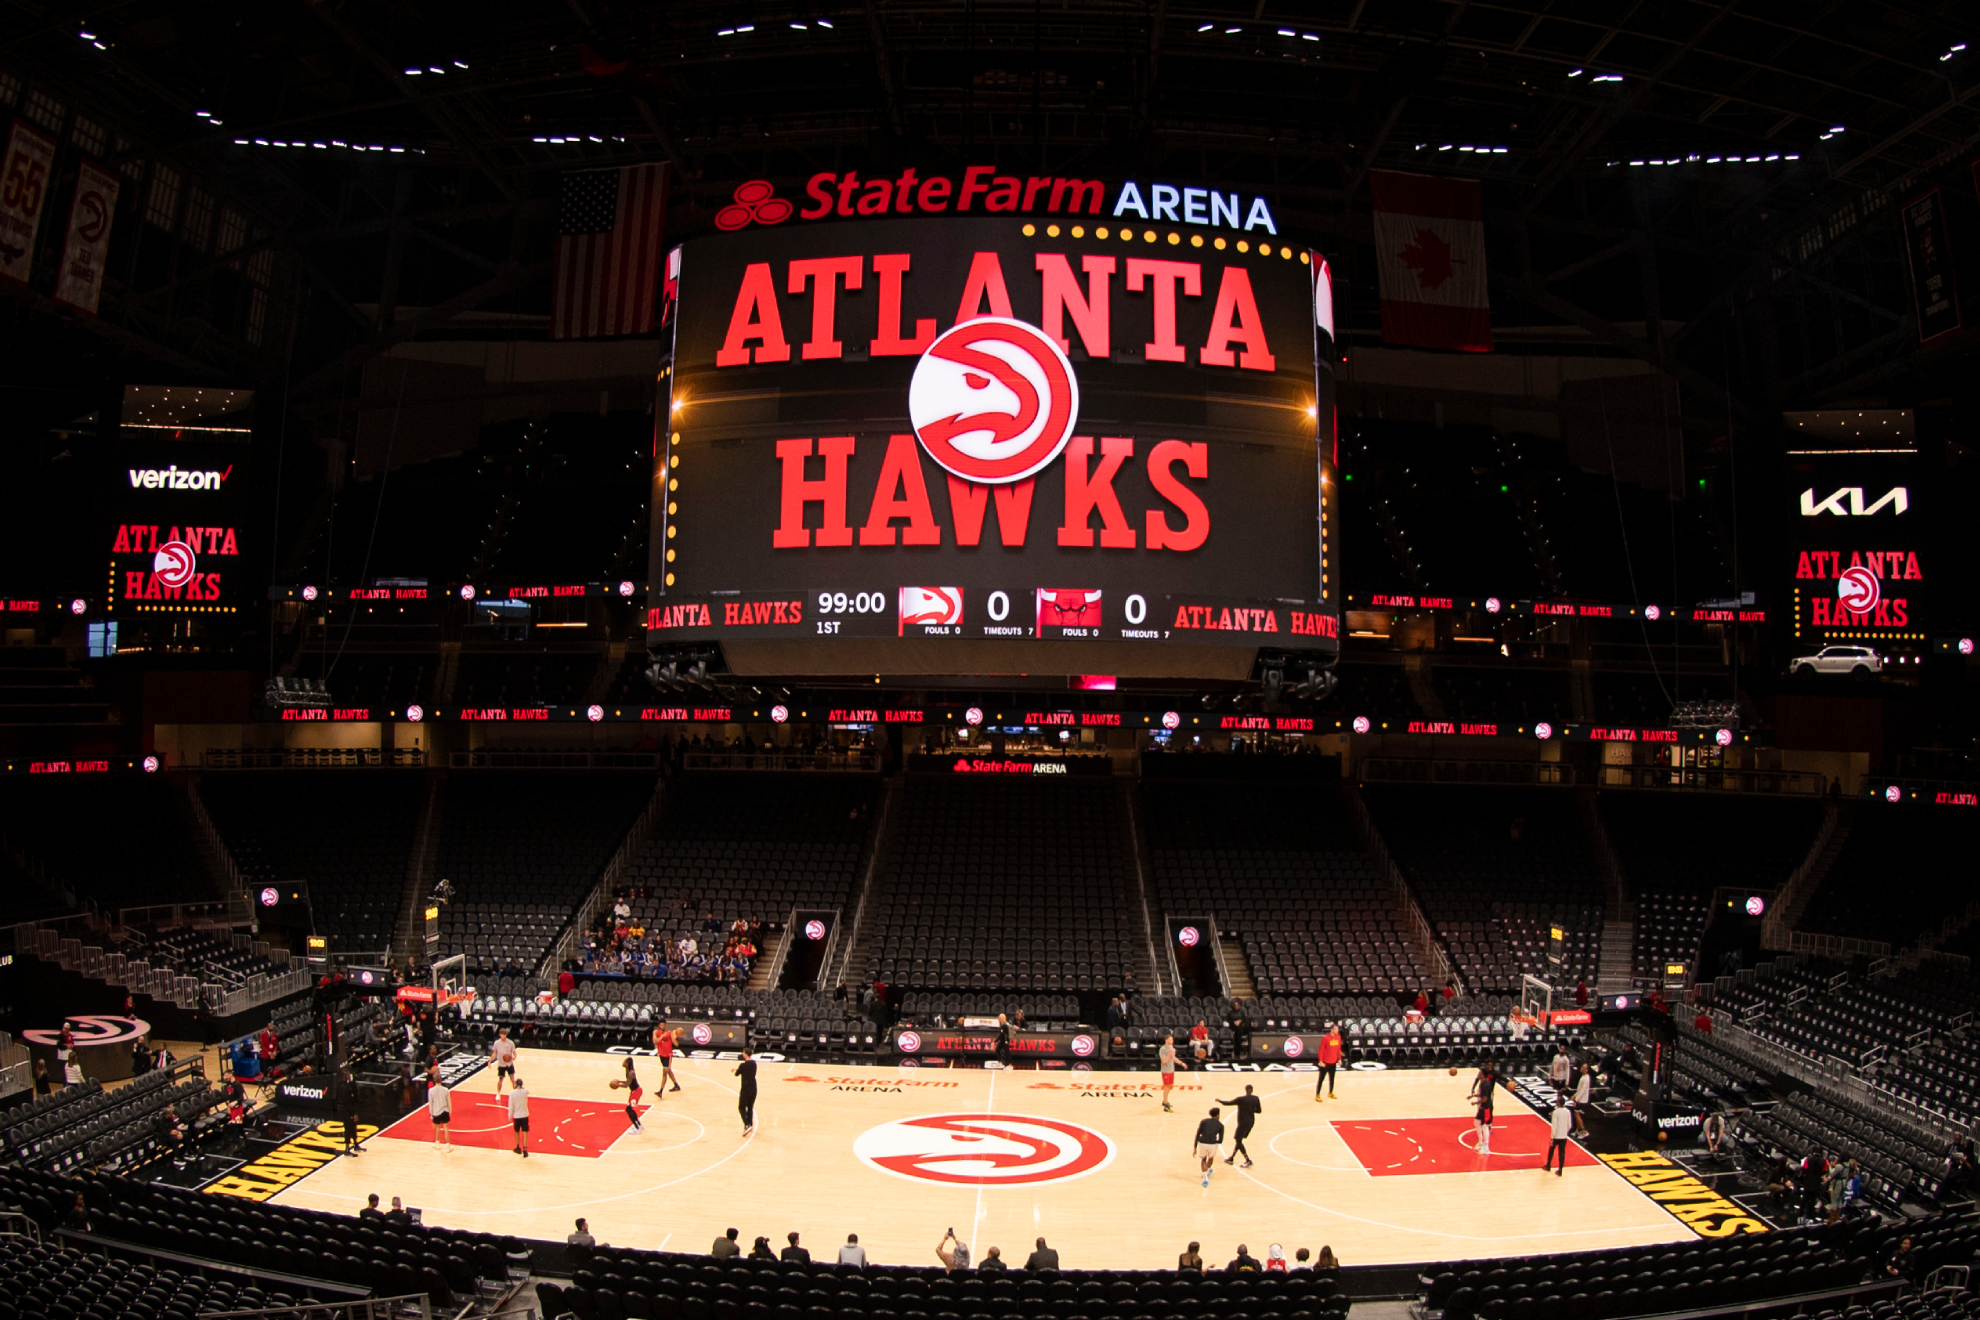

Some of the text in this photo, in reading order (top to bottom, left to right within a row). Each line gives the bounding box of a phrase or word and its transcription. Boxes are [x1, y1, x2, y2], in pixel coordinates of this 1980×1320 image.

[4, 150, 46, 218] 55
[1114, 183, 1276, 234] ARENA
[717, 252, 1276, 371] ATLANTA
[130, 465, 220, 489] verizon
[773, 434, 1209, 552] HAWKS
[1801, 488, 1907, 515] KIA
[113, 525, 238, 555] ATLANTA
[1796, 551, 1922, 579] ATLANTA
[350, 589, 427, 598] ATLANTA HAWKS
[509, 586, 585, 597] ATLANTA HAWKS
[9, 601, 39, 611] HAWKS
[819, 593, 885, 613] 99:00
[988, 591, 1009, 620] 0
[1372, 595, 1452, 608] ATLANTA HAWKS
[724, 601, 802, 625] HAWKS
[1125, 595, 1146, 624] 0
[1534, 604, 1611, 616] ATLANTA HAWKS
[1693, 611, 1734, 620] ATLANTA
[1174, 605, 1278, 632] ATLANTA
[817, 622, 840, 633] 1ST
[924, 626, 961, 635] FOULS 0
[984, 627, 1035, 636] TIMEOUTS 7
[1062, 628, 1099, 637] FOULS 0
[1121, 629, 1171, 640] TIMEOUTS 7
[282, 709, 368, 720] ATLANTA HAWKS
[461, 709, 548, 719] ATLANTA HAWKS
[641, 709, 730, 720] ATLANTA HAWKS
[829, 710, 923, 721] ATLANTA HAWKS
[1025, 713, 1121, 725] ATLANTA HAWKS
[1221, 717, 1313, 730] ATLANTA HAWKS
[1408, 722, 1497, 735] ATLANTA HAWKS
[1590, 729, 1677, 741] ATLANTA HAWKS
[30, 761, 108, 773] ATLANTA HAWKS
[1033, 763, 1067, 774] ARENA
[1936, 793, 1977, 805] ATLANTA
[1009, 1039, 1056, 1052] HAWKS
[284, 1085, 322, 1098] verizon
[830, 1085, 902, 1093] ARENA
[1658, 1115, 1698, 1127] verizon
[202, 1120, 379, 1202] HAWKS
[1597, 1150, 1769, 1238] HAWKS
